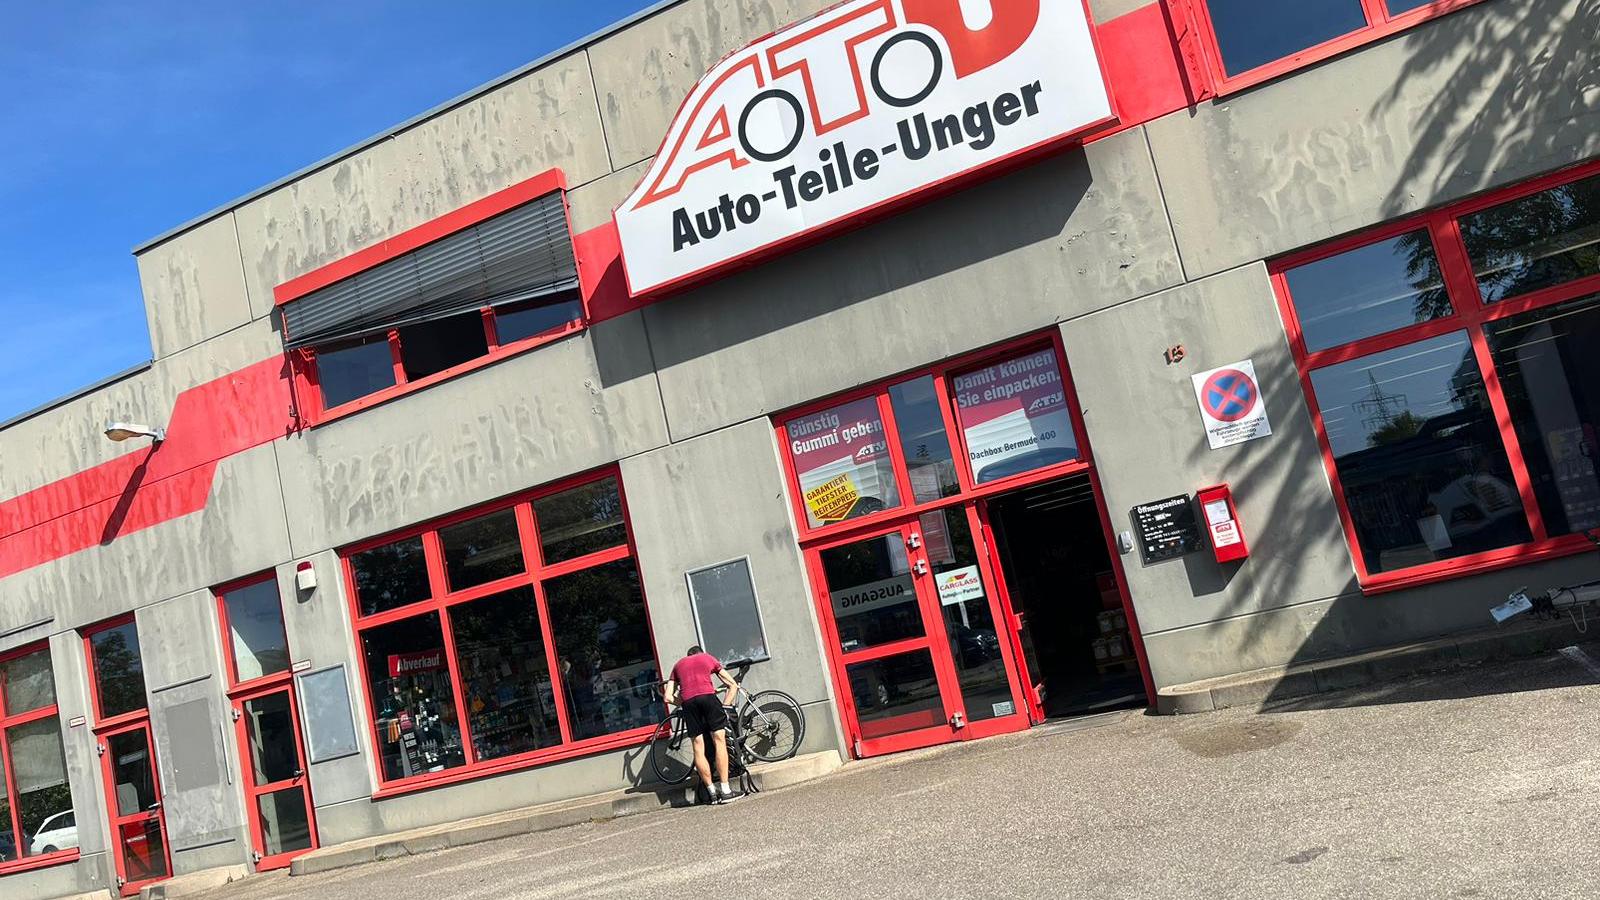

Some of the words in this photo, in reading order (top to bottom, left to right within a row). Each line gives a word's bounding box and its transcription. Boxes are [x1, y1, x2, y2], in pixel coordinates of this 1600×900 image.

[672, 79, 1041, 252] Auto-Teile-Unger
[953, 366, 997, 391] Damit
[1000, 353, 1053, 378] können
[957, 390, 980, 408] Sie
[984, 371, 1061, 402] einpacken.
[789, 412, 840, 438] Günstig
[792, 429, 841, 455] Gummi
[842, 419, 882, 444] geben
[970, 446, 1003, 460] Dachbox
[1003, 437, 1038, 452] Bermude
[1040, 430, 1057, 441] 400
[806, 473, 848, 501] GARANTIERT
[815, 485, 848, 506] TIEFSTER
[813, 490, 857, 518] REIFENPREIS
[1137, 498, 1186, 514] Öffnungszeiten
[939, 576, 978, 591] CARGLASS
[396, 653, 441, 672] Abverkauf
